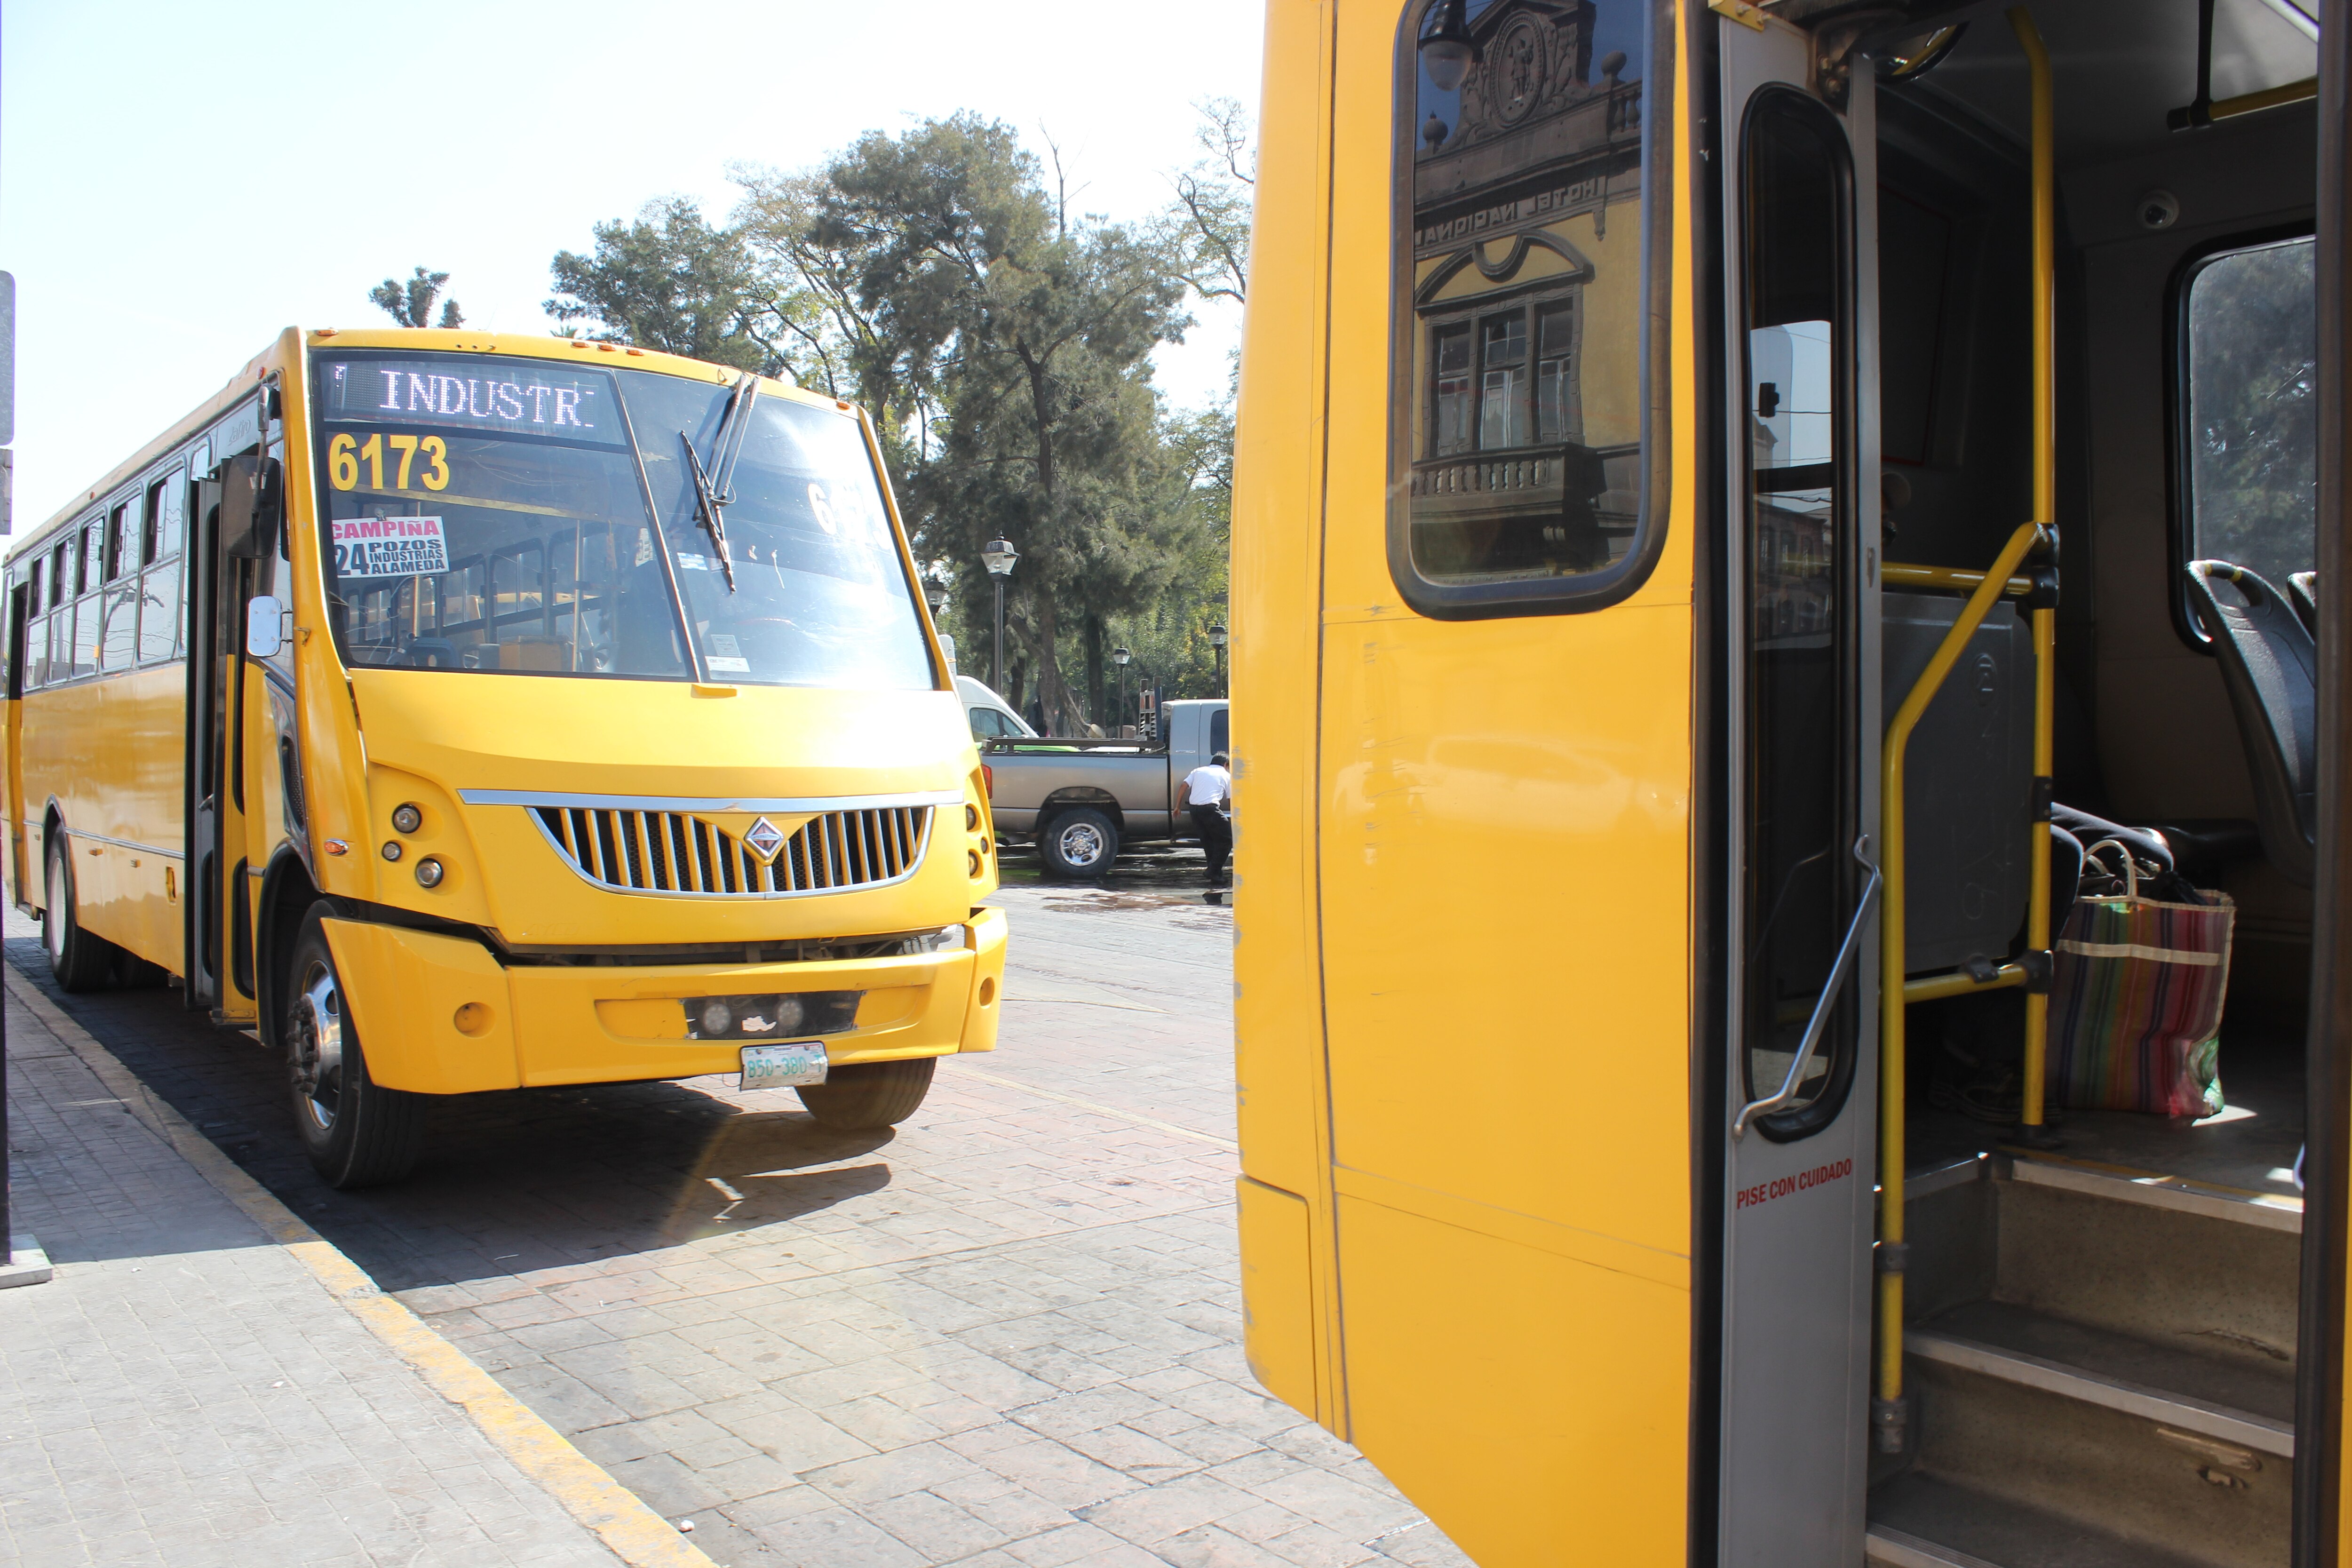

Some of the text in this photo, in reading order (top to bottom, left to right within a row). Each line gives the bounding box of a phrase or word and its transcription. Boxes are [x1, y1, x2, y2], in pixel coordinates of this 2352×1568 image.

[380, 371, 594, 427] INDUSTR
[330, 434, 449, 491] 6173
[332, 520, 439, 539] CAMPIÑA
[368, 539, 442, 552] POZOS
[369, 549, 443, 563] INDUSTRIAS
[334, 544, 369, 575] 24
[372, 559, 445, 574] ALAMEDA
[1737, 1158, 1852, 1209] PISE CON CUIDADO
